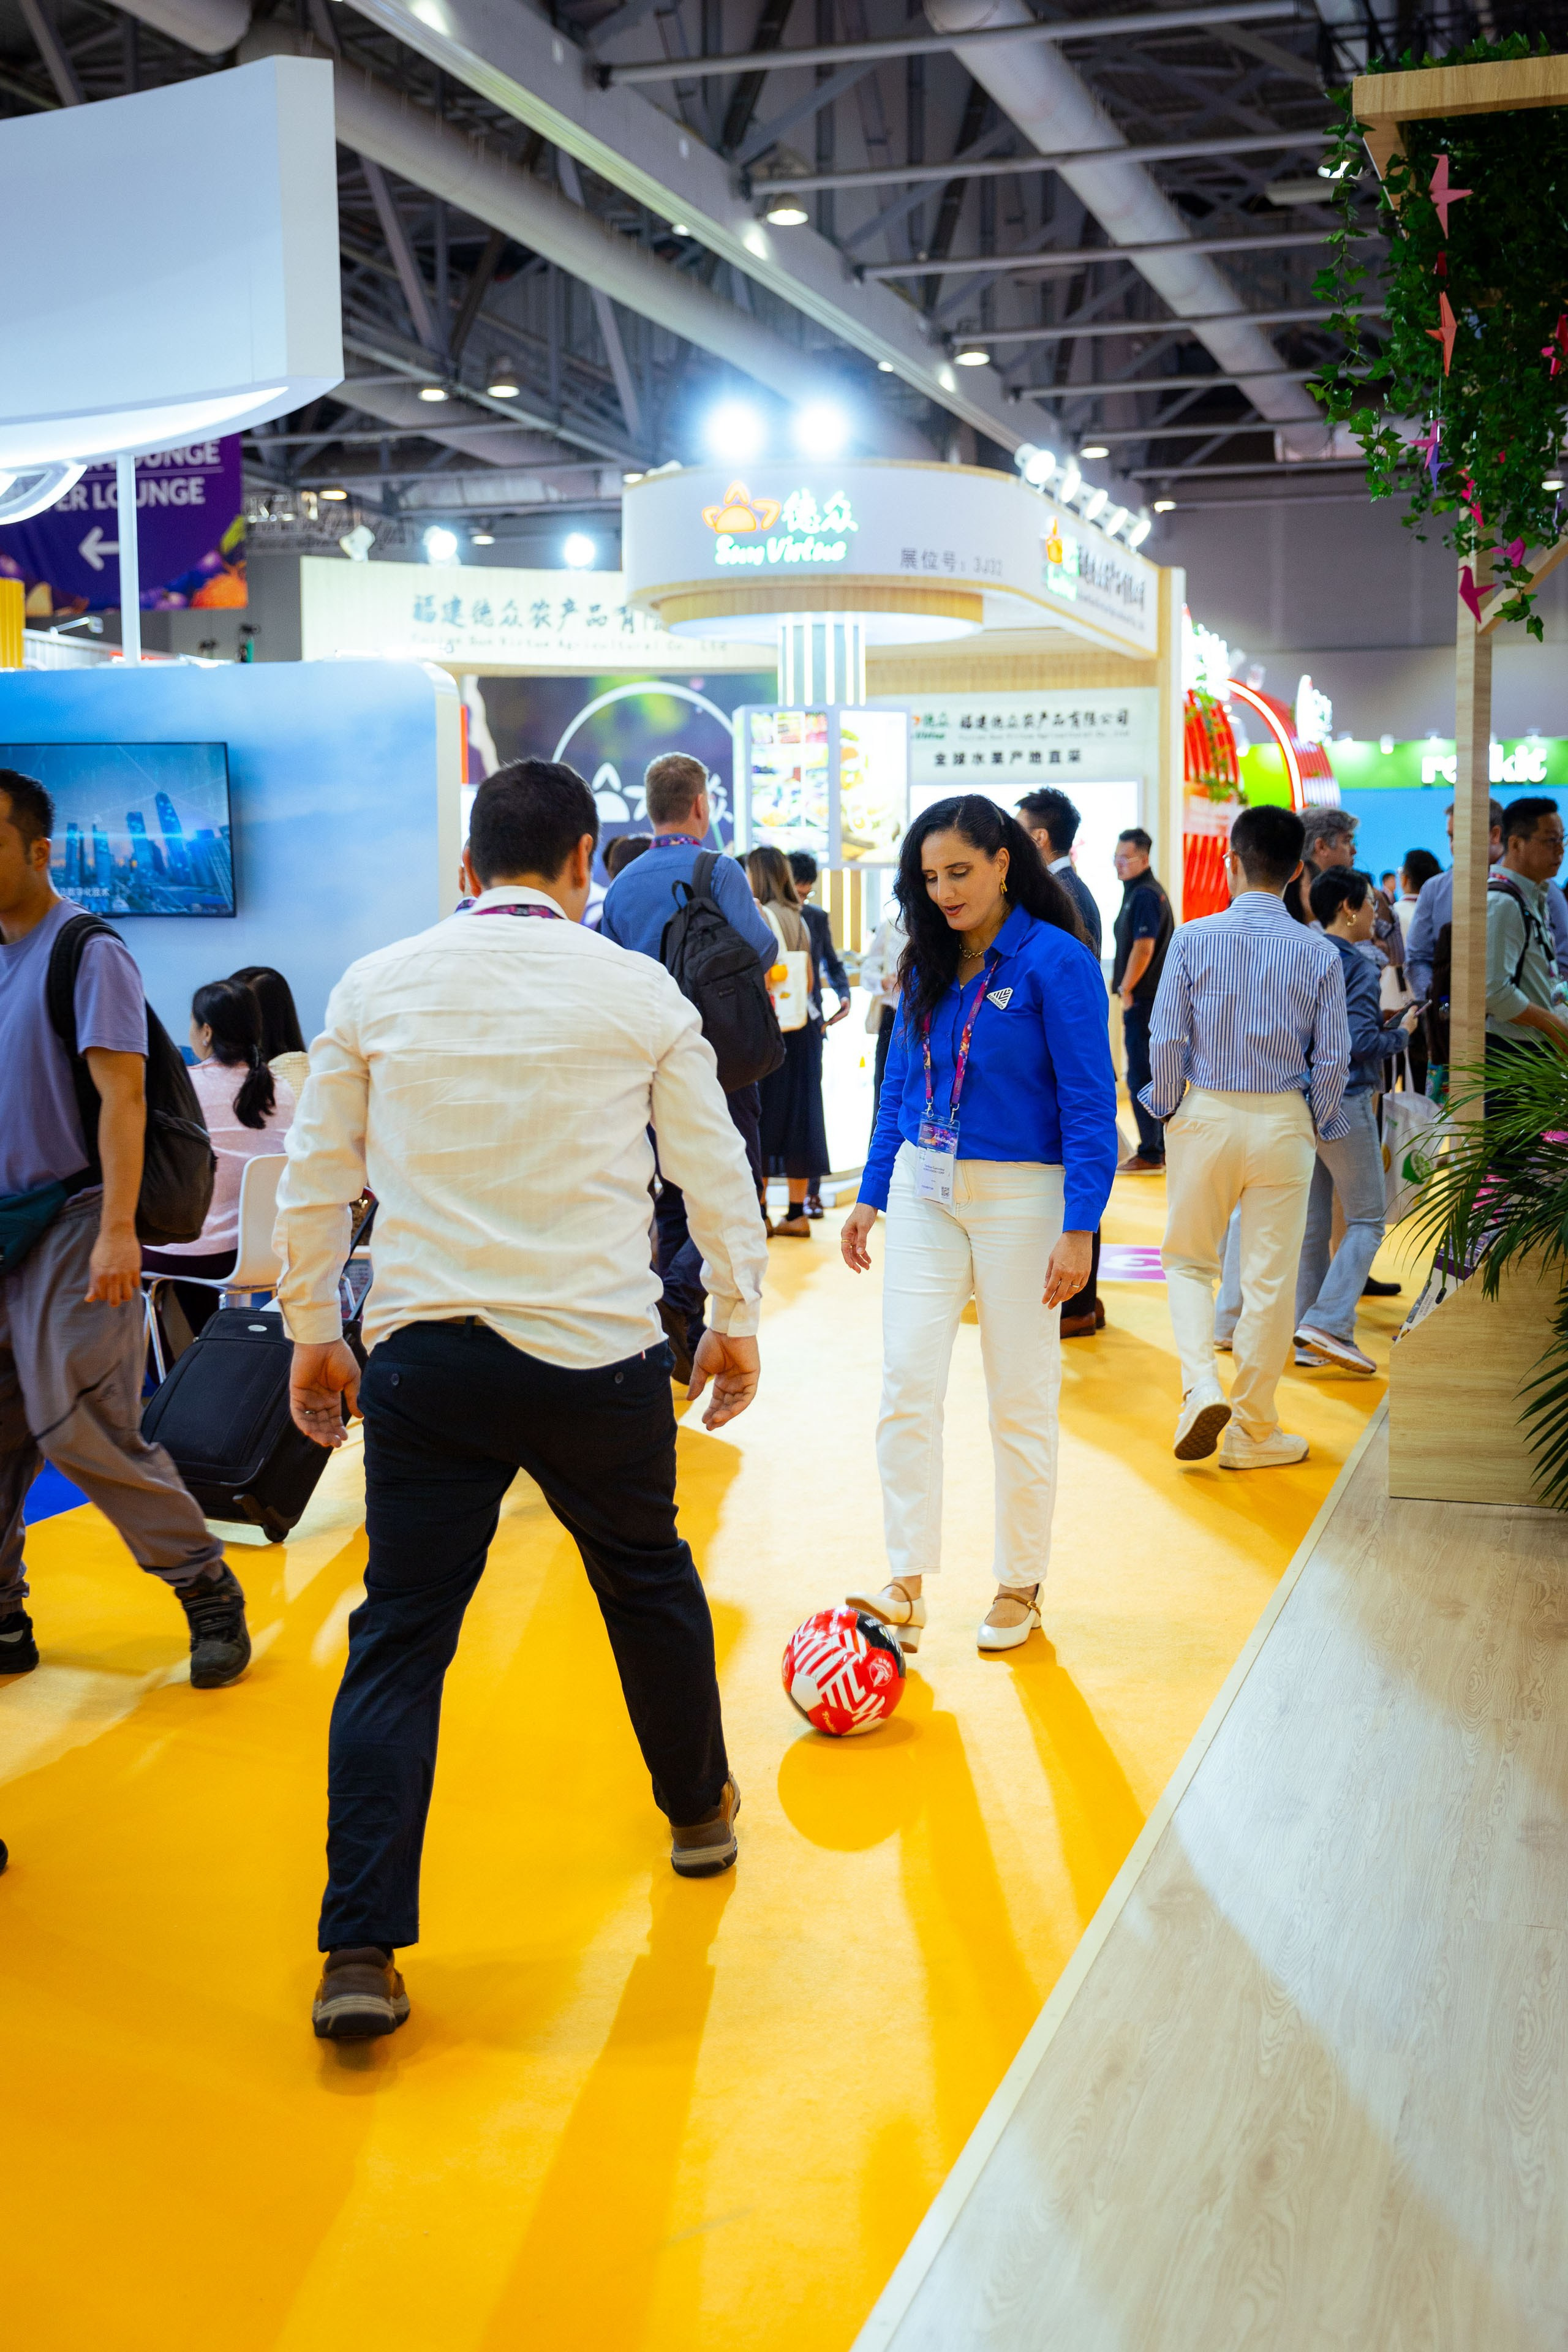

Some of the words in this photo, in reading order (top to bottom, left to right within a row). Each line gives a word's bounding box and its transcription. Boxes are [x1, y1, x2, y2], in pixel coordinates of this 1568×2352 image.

[715, 534, 765, 566] Sun
[766, 535, 847, 564] Virtue
[987, 994, 1005, 1009] AGROVISION
